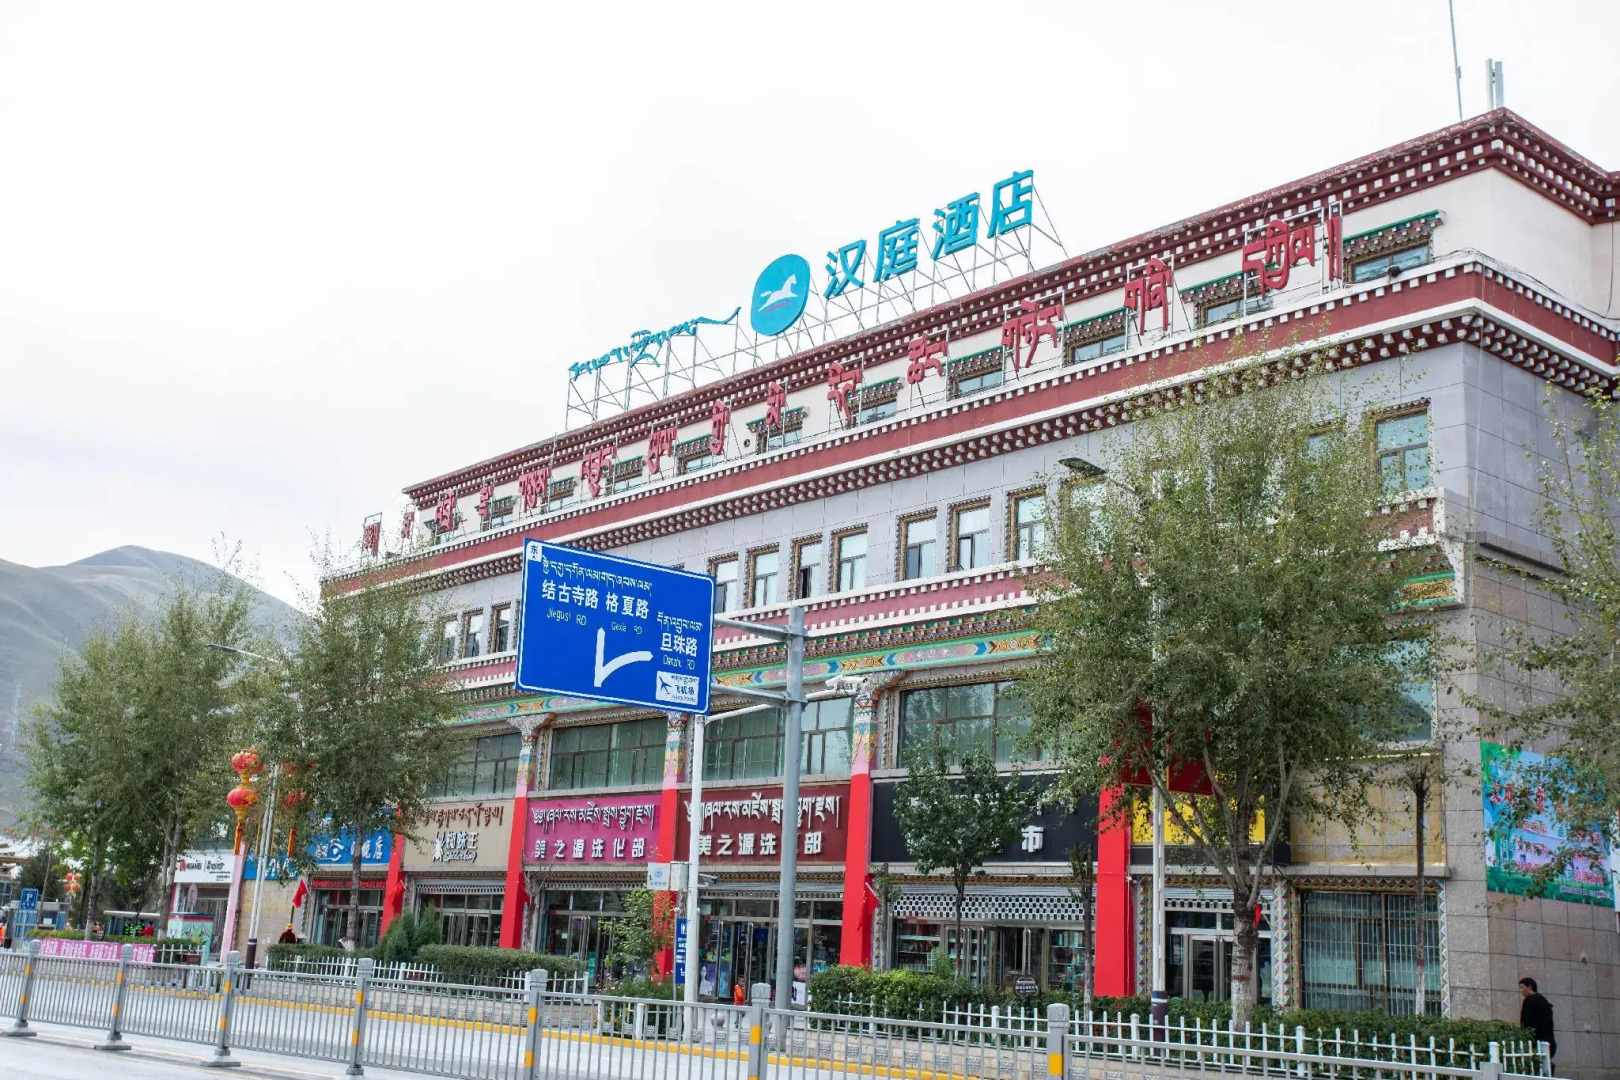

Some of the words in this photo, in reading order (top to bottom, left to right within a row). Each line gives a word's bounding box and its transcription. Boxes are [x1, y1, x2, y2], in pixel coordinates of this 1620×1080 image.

[823, 169, 1034, 299] 汉庭酒店
[530, 545, 538, 555] 东
[541, 578, 599, 610] 结古寺路
[605, 591, 650, 620] 格夏路
[576, 614, 587, 626] RD
[611, 621, 627, 633] Gexia
[633, 625, 643, 635] RD
[660, 632, 698, 658] 旦珠路
[674, 684, 695, 696] 飞机场
[445, 830, 479, 850] 蜘蛛王
[534, 837, 645, 859] 美之源洗化部
[698, 831, 823, 856] 美之源洗部
[26, 893, 33, 902] P
